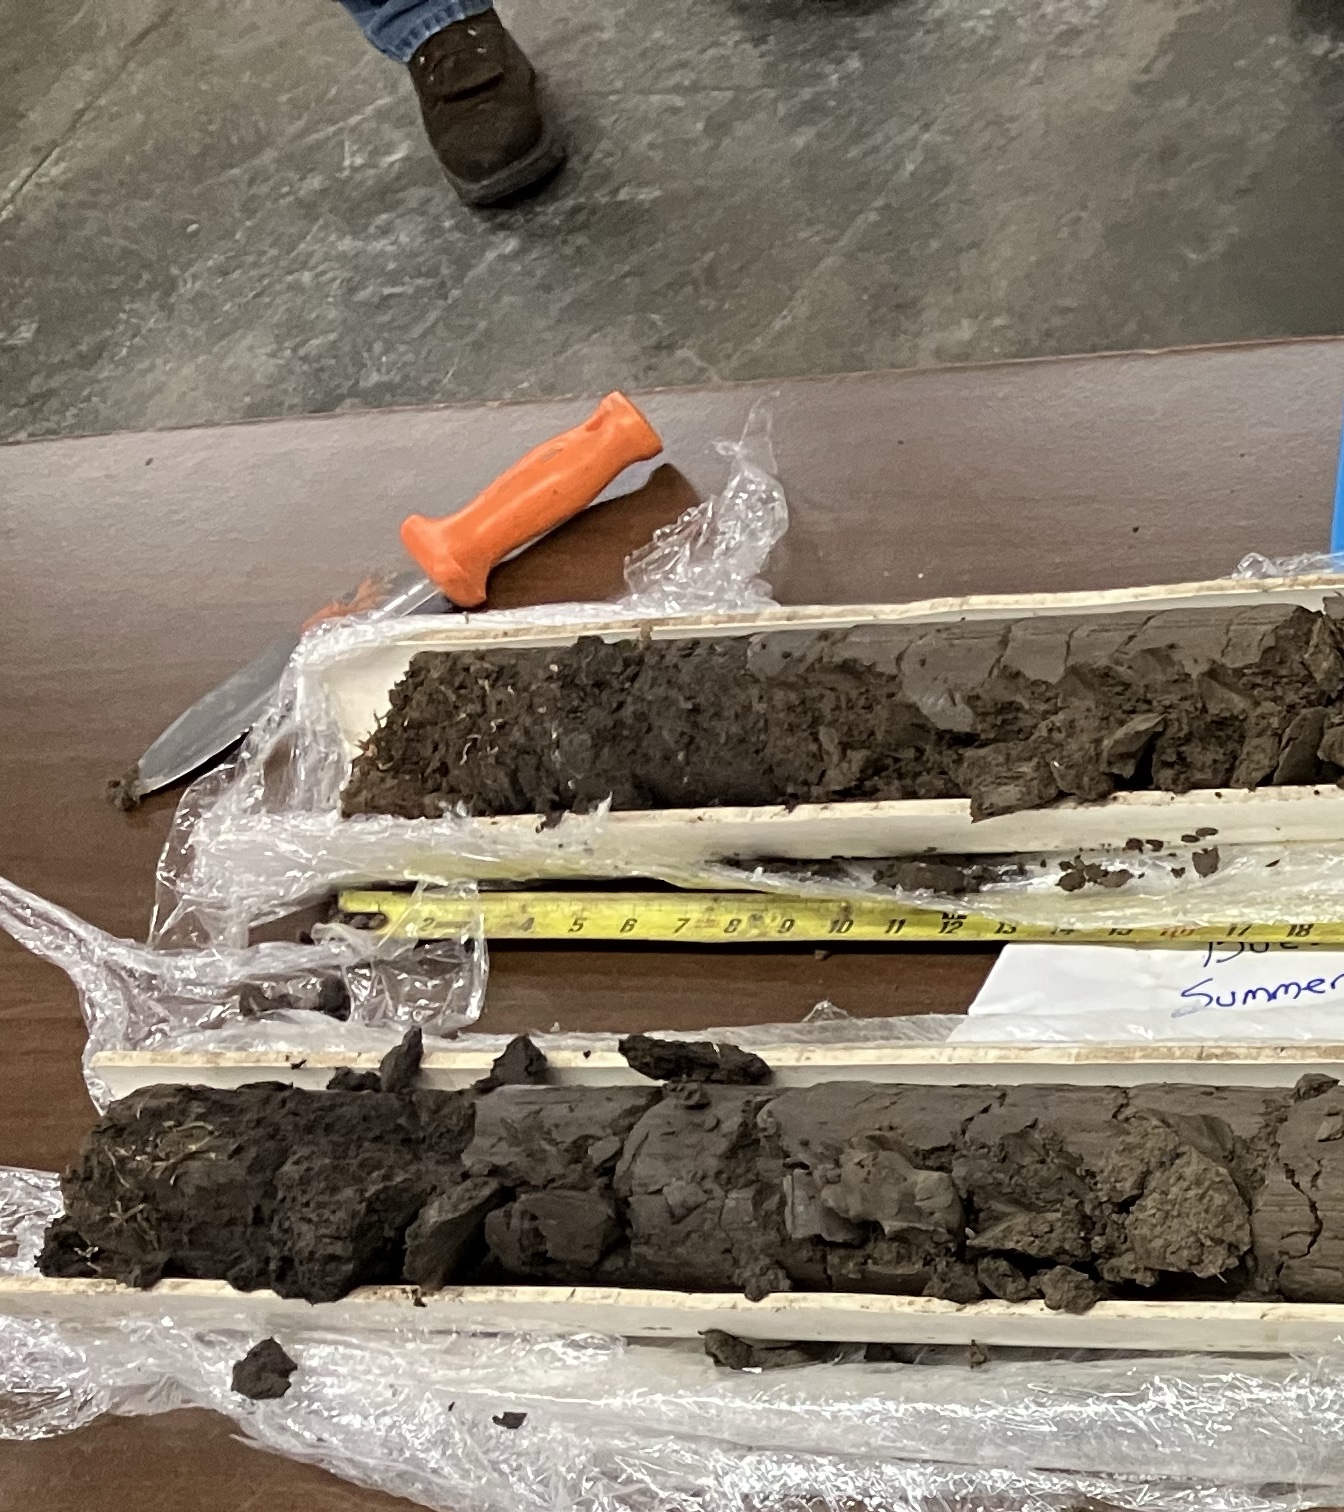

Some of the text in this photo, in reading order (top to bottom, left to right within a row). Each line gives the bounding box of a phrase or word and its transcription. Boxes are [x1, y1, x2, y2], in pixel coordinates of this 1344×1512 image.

[567, 917, 588, 932] 5
[619, 918, 638, 933] 6
[672, 918, 691, 933] 7
[723, 918, 742, 934] 8
[776, 919, 796, 934] 9
[828, 919, 854, 934] 10
[885, 919, 906, 934] 11
[938, 920, 964, 934] 12
[1226, 924, 1253, 937] 17
[1286, 923, 1314, 938] 18
